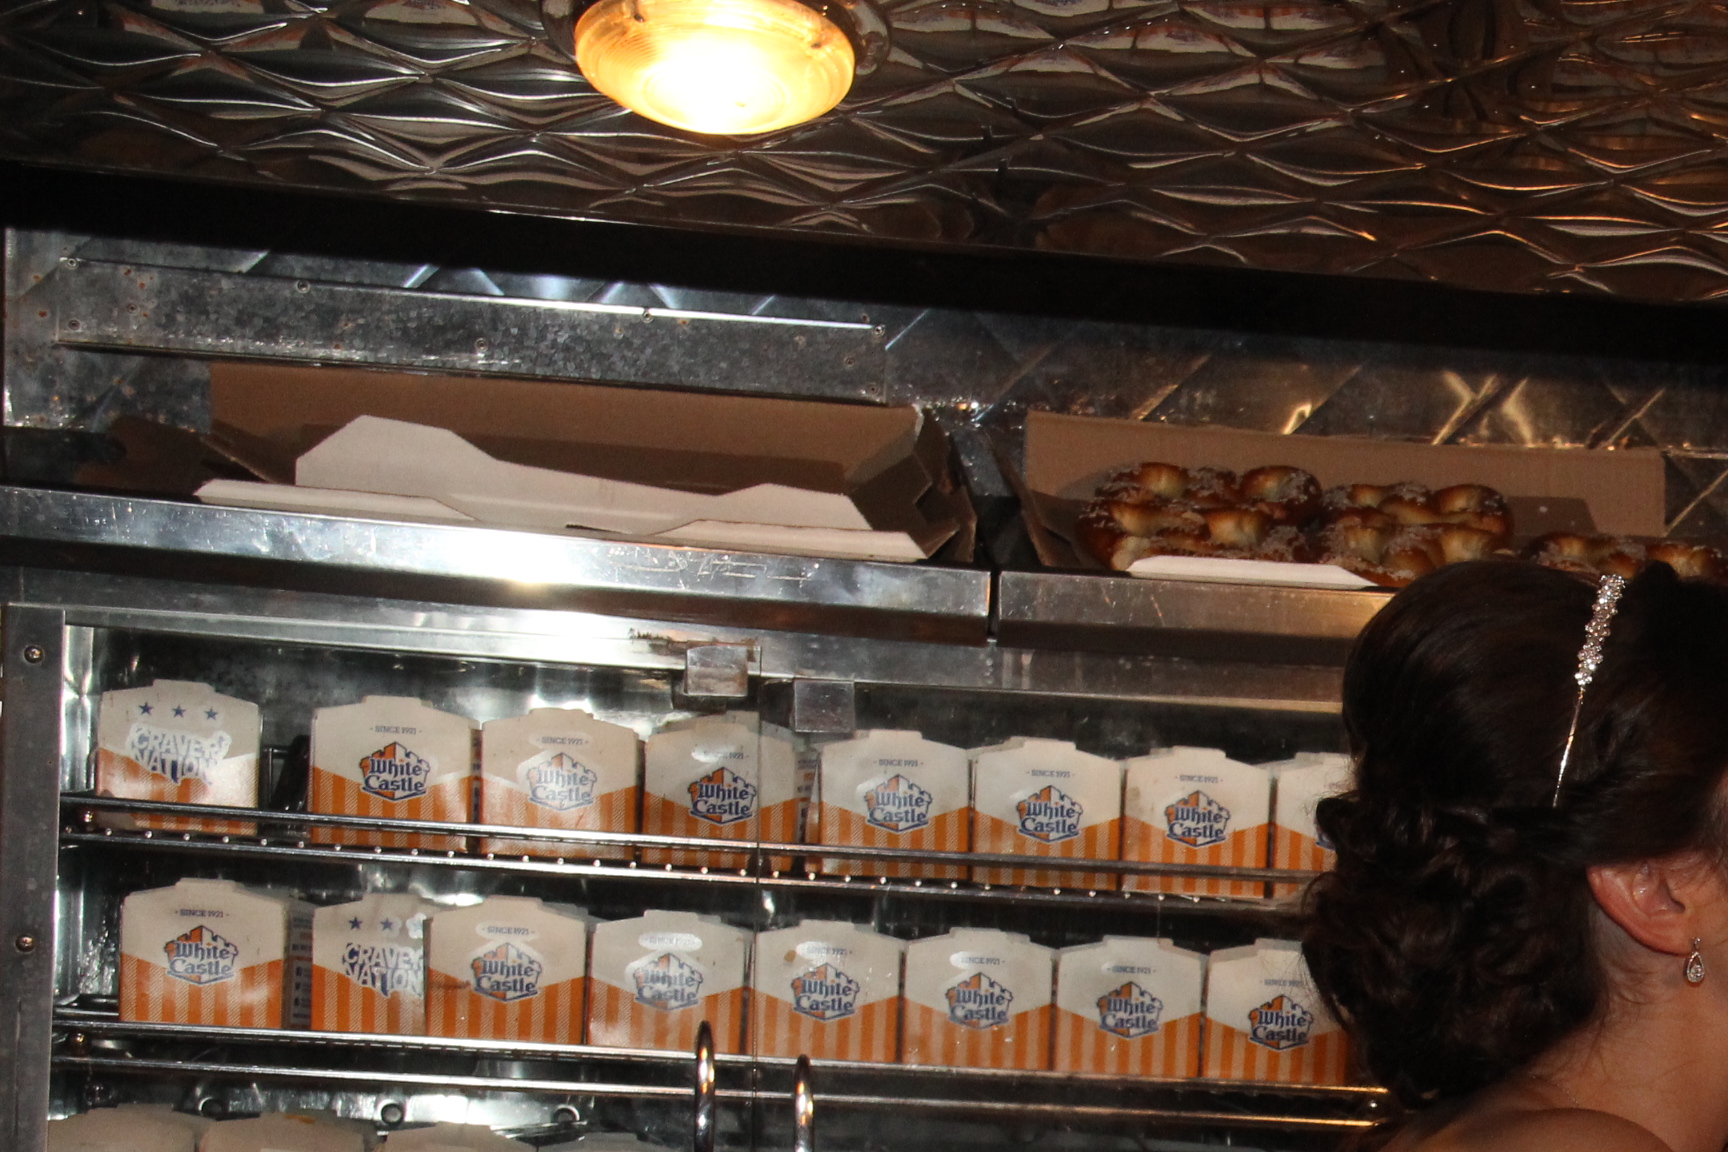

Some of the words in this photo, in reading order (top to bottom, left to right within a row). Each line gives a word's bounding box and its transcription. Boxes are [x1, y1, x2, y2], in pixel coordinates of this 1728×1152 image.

[370, 759, 422, 777] White
[365, 776, 424, 791] Castle
[537, 770, 589, 788] White
[531, 786, 590, 801] Castle
[698, 784, 749, 802] White
[875, 792, 924, 809] White
[693, 800, 750, 815] Castle
[870, 807, 926, 823] Castle
[1026, 803, 1075, 819] White
[1175, 807, 1223, 824] White
[1021, 818, 1077, 833] Castle
[1169, 823, 1224, 838] Castle
[180, 909, 206, 917] SINCE
[176, 943, 230, 961] White
[170, 959, 231, 975] Castle
[483, 960, 534, 978] White
[477, 976, 535, 992] Castle
[645, 970, 694, 987] White
[639, 985, 696, 1001] Castle
[802, 979, 852, 997] White
[797, 995, 853, 1011] Castle
[956, 989, 1004, 1007] White
[951, 1006, 1007, 1021] Castle
[1108, 998, 1154, 1015] White
[1102, 1013, 1157, 1029] Castle
[1259, 1011, 1306, 1027] White
[1253, 1026, 1307, 1041] Castle
